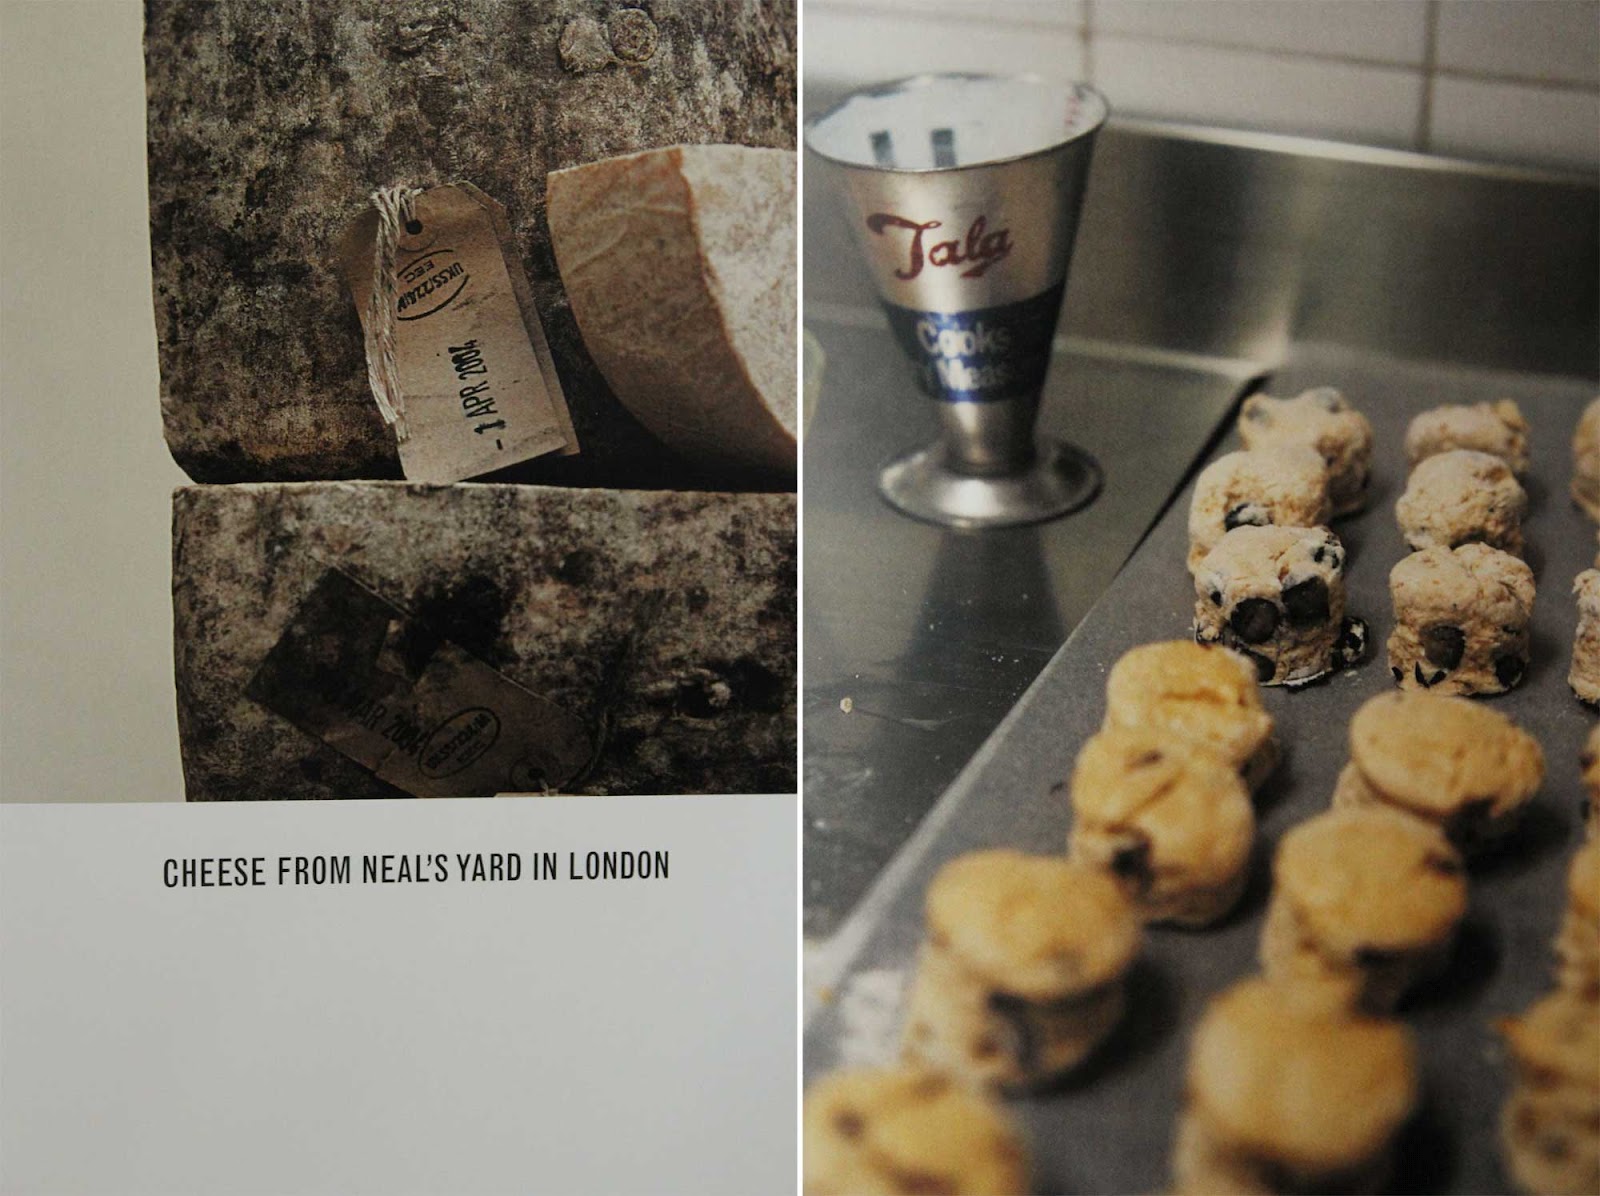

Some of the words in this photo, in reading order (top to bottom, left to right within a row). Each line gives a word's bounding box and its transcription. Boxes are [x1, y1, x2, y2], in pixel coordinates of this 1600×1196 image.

[866, 213, 1014, 281] Tala
[404, 260, 434, 283] EEC
[460, 380, 498, 418] APR
[163, 858, 266, 888] CHEESE
[278, 855, 351, 886] FROM
[363, 853, 449, 884] NEAL'S
[456, 852, 522, 882] YARD
[533, 852, 557, 881] IN
[569, 850, 669, 880] LONDON
